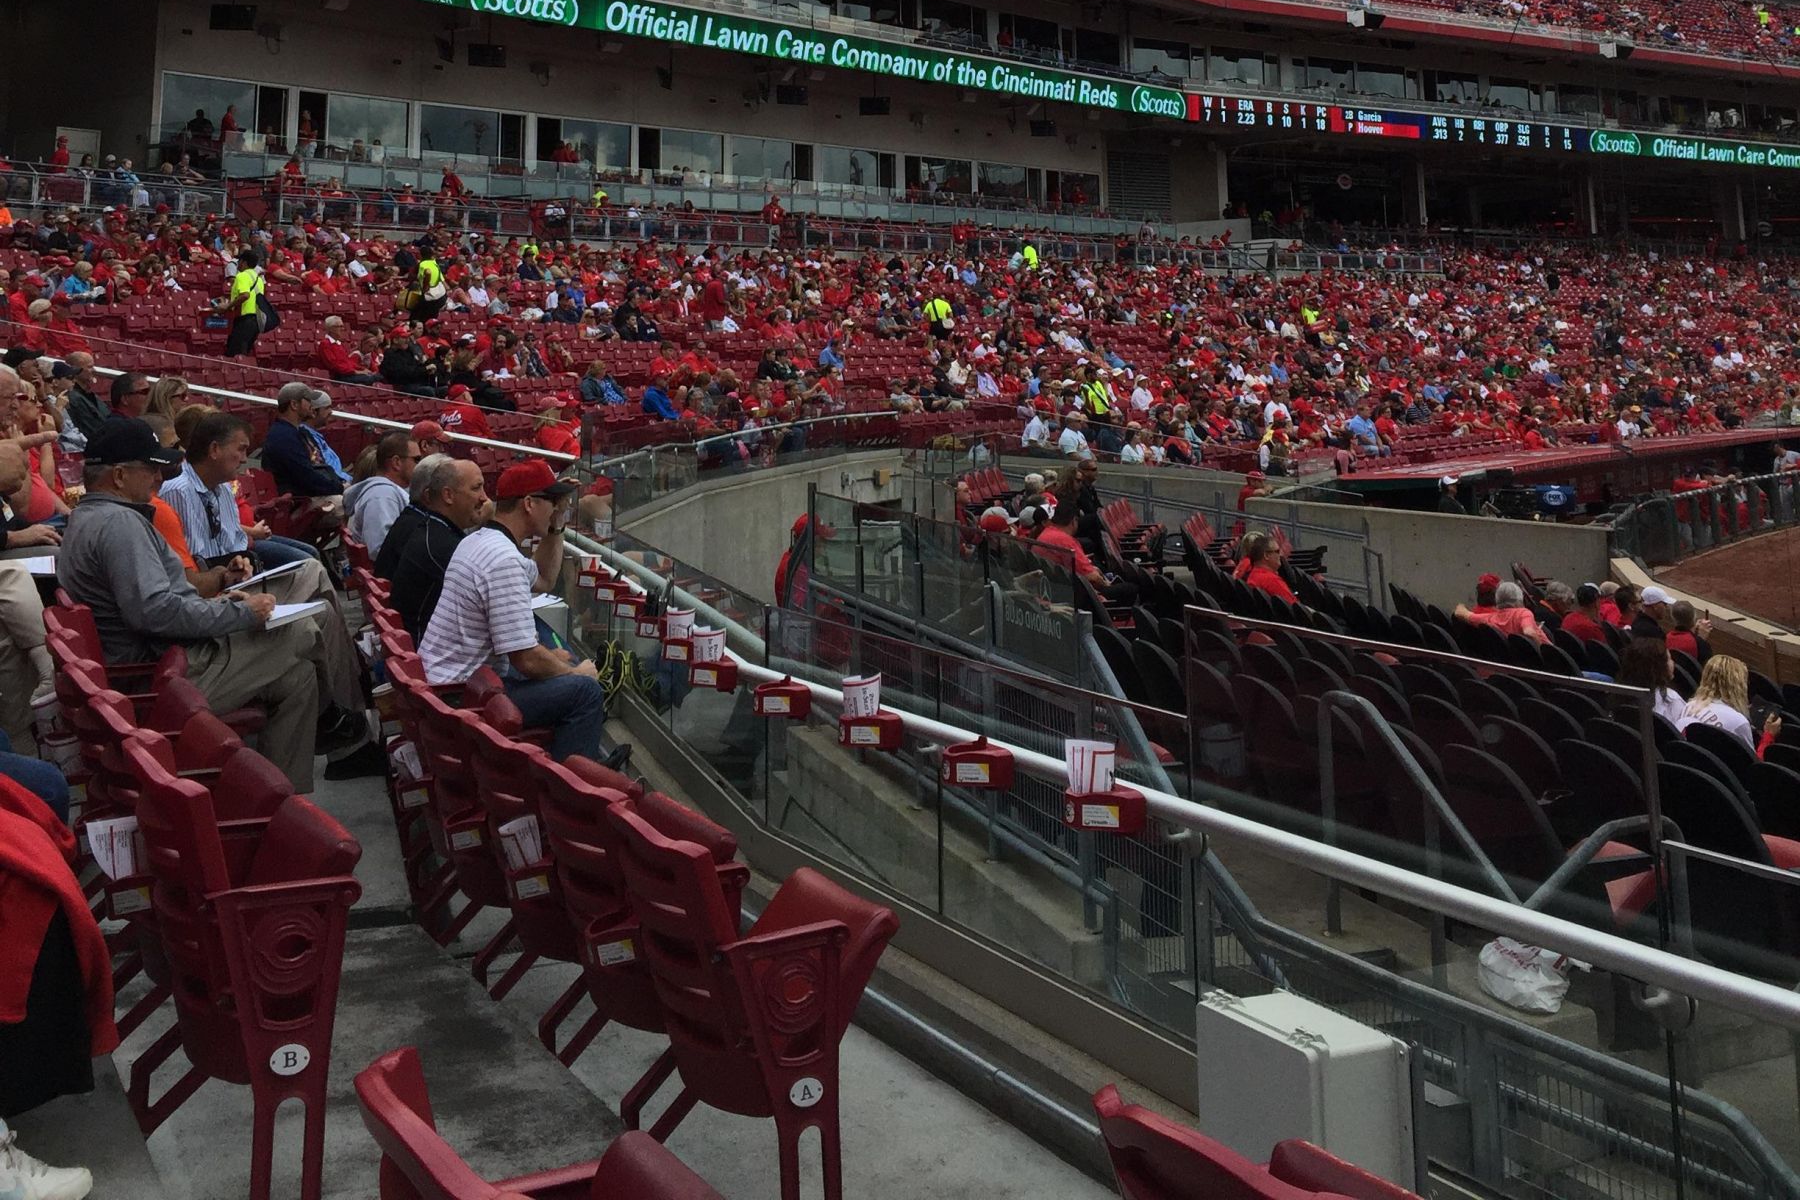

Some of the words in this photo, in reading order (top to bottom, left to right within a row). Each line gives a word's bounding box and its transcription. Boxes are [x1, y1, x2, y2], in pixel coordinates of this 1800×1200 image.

[605, 1, 698, 43] Official
[703, 17, 769, 54] Lawn
[775, 29, 826, 62] Care
[831, 38, 929, 80] Company
[933, 57, 954, 82] of
[957, 61, 986, 87] the
[991, 65, 1076, 103] Cincinnati
[1079, 80, 1118, 108] Reds
[1139, 90, 1181, 117] Scotts
[1203, 96, 1212, 108] W
[1220, 98, 1226, 109] L
[1238, 99, 1254, 111] ERA
[1266, 102, 1272, 113] B
[1283, 103, 1289, 114] S
[1300, 105, 1306, 116] K
[1316, 106, 1327, 118] PC
[1205, 109, 1211, 121] 7
[1221, 111, 1226, 123] 1
[1237, 112, 1255, 124] 2.23
[1267, 114, 1273, 126] 8
[1281, 115, 1292, 128] 10
[1301, 117, 1306, 129] 1
[1315, 118, 1326, 130] 18
[1345, 110, 1354, 120] 2B
[1357, 110, 1382, 122] Garcia
[1432, 116, 1447, 128] AVG
[1494, 121, 1509, 132] OBP
[1517, 124, 1530, 135] SLG
[1348, 122, 1353, 132] P
[1357, 121, 1384, 134] Hoover
[1432, 128, 1448, 140] .313
[1458, 130, 1463, 141] 2
[1479, 132, 1485, 143] 4
[1544, 137, 1550, 148] 5
[1563, 139, 1572, 150] 15
[1596, 133, 1636, 154] Scotts
[1653, 138, 1698, 159] Official
[1701, 142, 1734, 162] Lawn
[1738, 146, 1765, 164] Care
[283, 1051, 297, 1068] B
[801, 1084, 814, 1101] A
